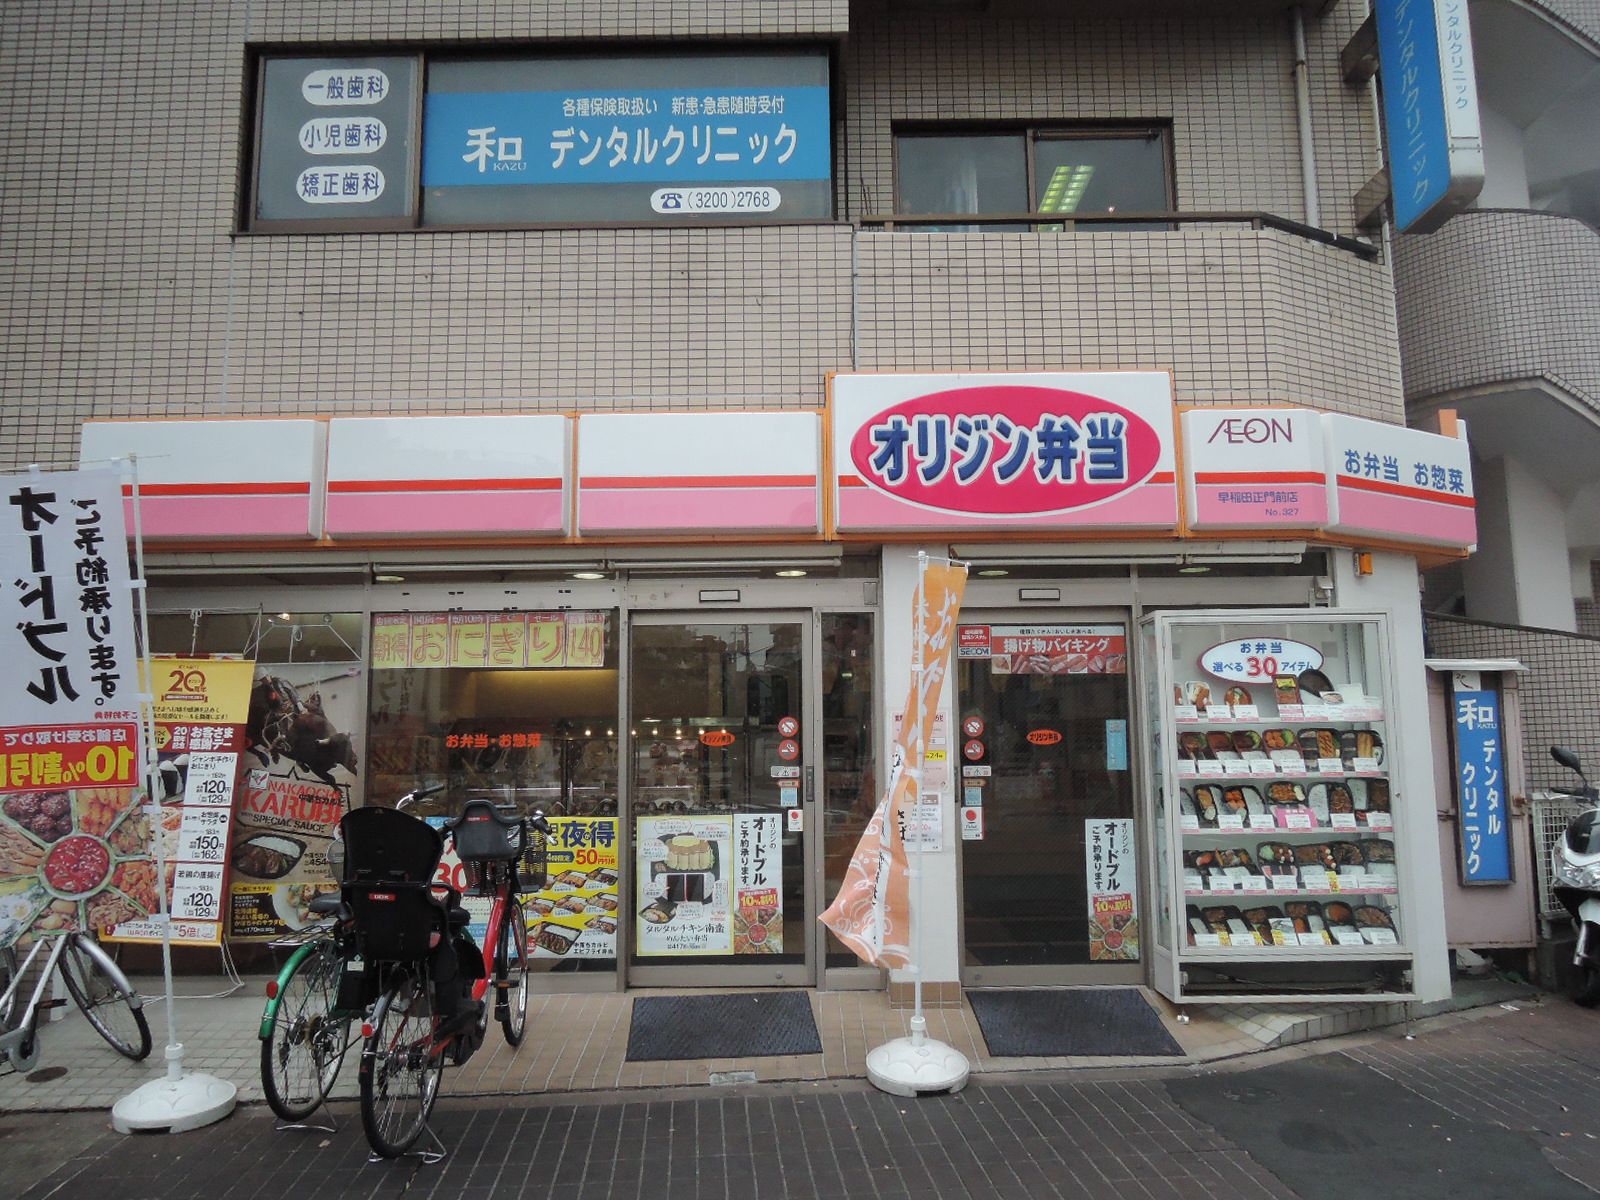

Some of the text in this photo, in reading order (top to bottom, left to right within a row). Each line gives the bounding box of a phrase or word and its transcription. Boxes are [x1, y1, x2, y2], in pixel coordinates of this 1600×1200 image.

[307, 76, 384, 99] 一般歯科
[563, 95, 785, 117] 各種保険取扱い 新患・急患随時受付
[303, 124, 382, 148] 小児歯科
[463, 123, 798, 173] 和 デンタルクリニック
[493, 163, 526, 171] KAZU
[301, 171, 380, 197] 矯正歯科
[687, 191, 770, 210] (3200)2768
[870, 413, 1128, 486] オリジン弁当
[1345, 449, 1465, 494] お弁当 お惣菜
[1218, 491, 1298, 503] 早稲田正門前店
[960, 648, 989, 656] SECOM
[1004, 638, 1109, 653] 揚げ物バイキング
[1240, 642, 1282, 654] お弁当
[1213, 656, 1313, 677] 選べる 30 アイテム
[1457, 698, 1494, 730] 和
[191, 726, 234, 739] お客さま
[447, 733, 543, 748] お弁当・お惣菜
[253, 813, 292, 828] SPECIAL
[294, 820, 326, 833] SAUCE
[1462, 762, 1481, 874] クリニック
[769, 816, 777, 849] オリジンの
[752, 816, 767, 886] オードブル
[1104, 822, 1120, 891] オードブル
[646, 923, 725, 934] タルタルチキン南蛮
